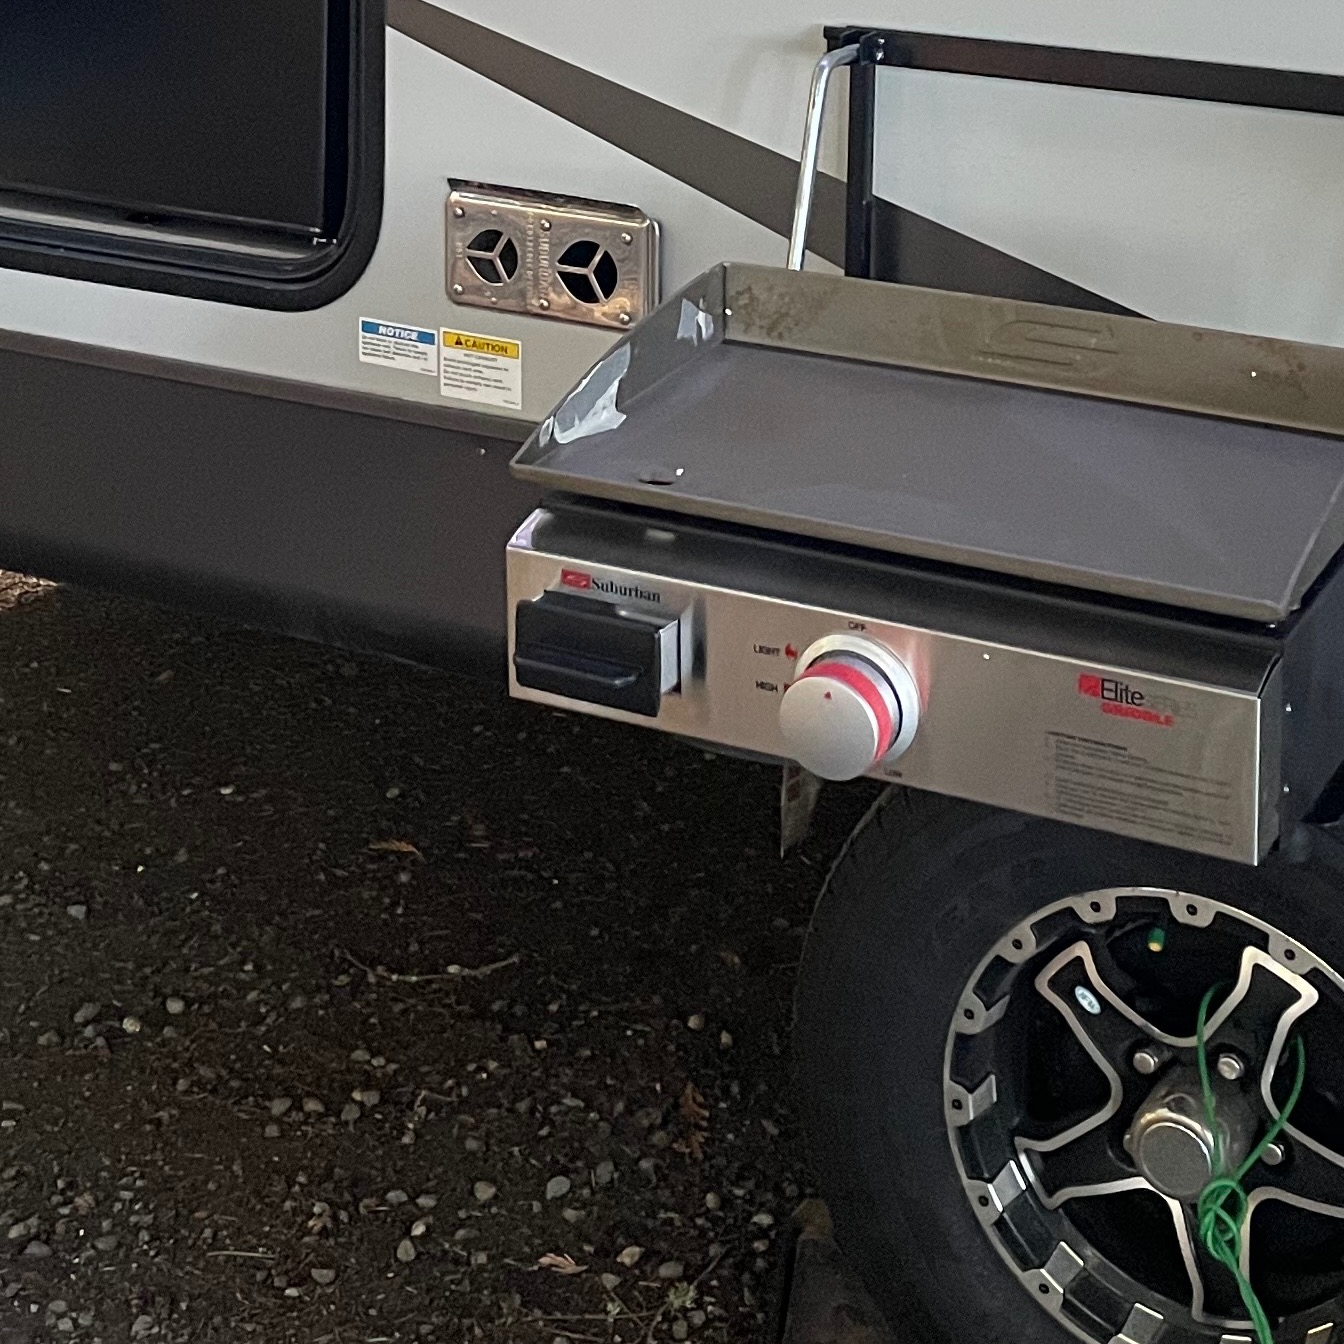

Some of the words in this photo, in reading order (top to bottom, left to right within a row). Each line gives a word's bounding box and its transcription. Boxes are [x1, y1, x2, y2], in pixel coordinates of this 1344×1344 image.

[378, 325, 419, 340] NOTICE
[465, 338, 509, 355] CAUTION
[592, 577, 660, 603] Suburban
[753, 643, 780, 657] LIGHT
[755, 679, 779, 694] HIGH
[1101, 677, 1145, 707] Elite
